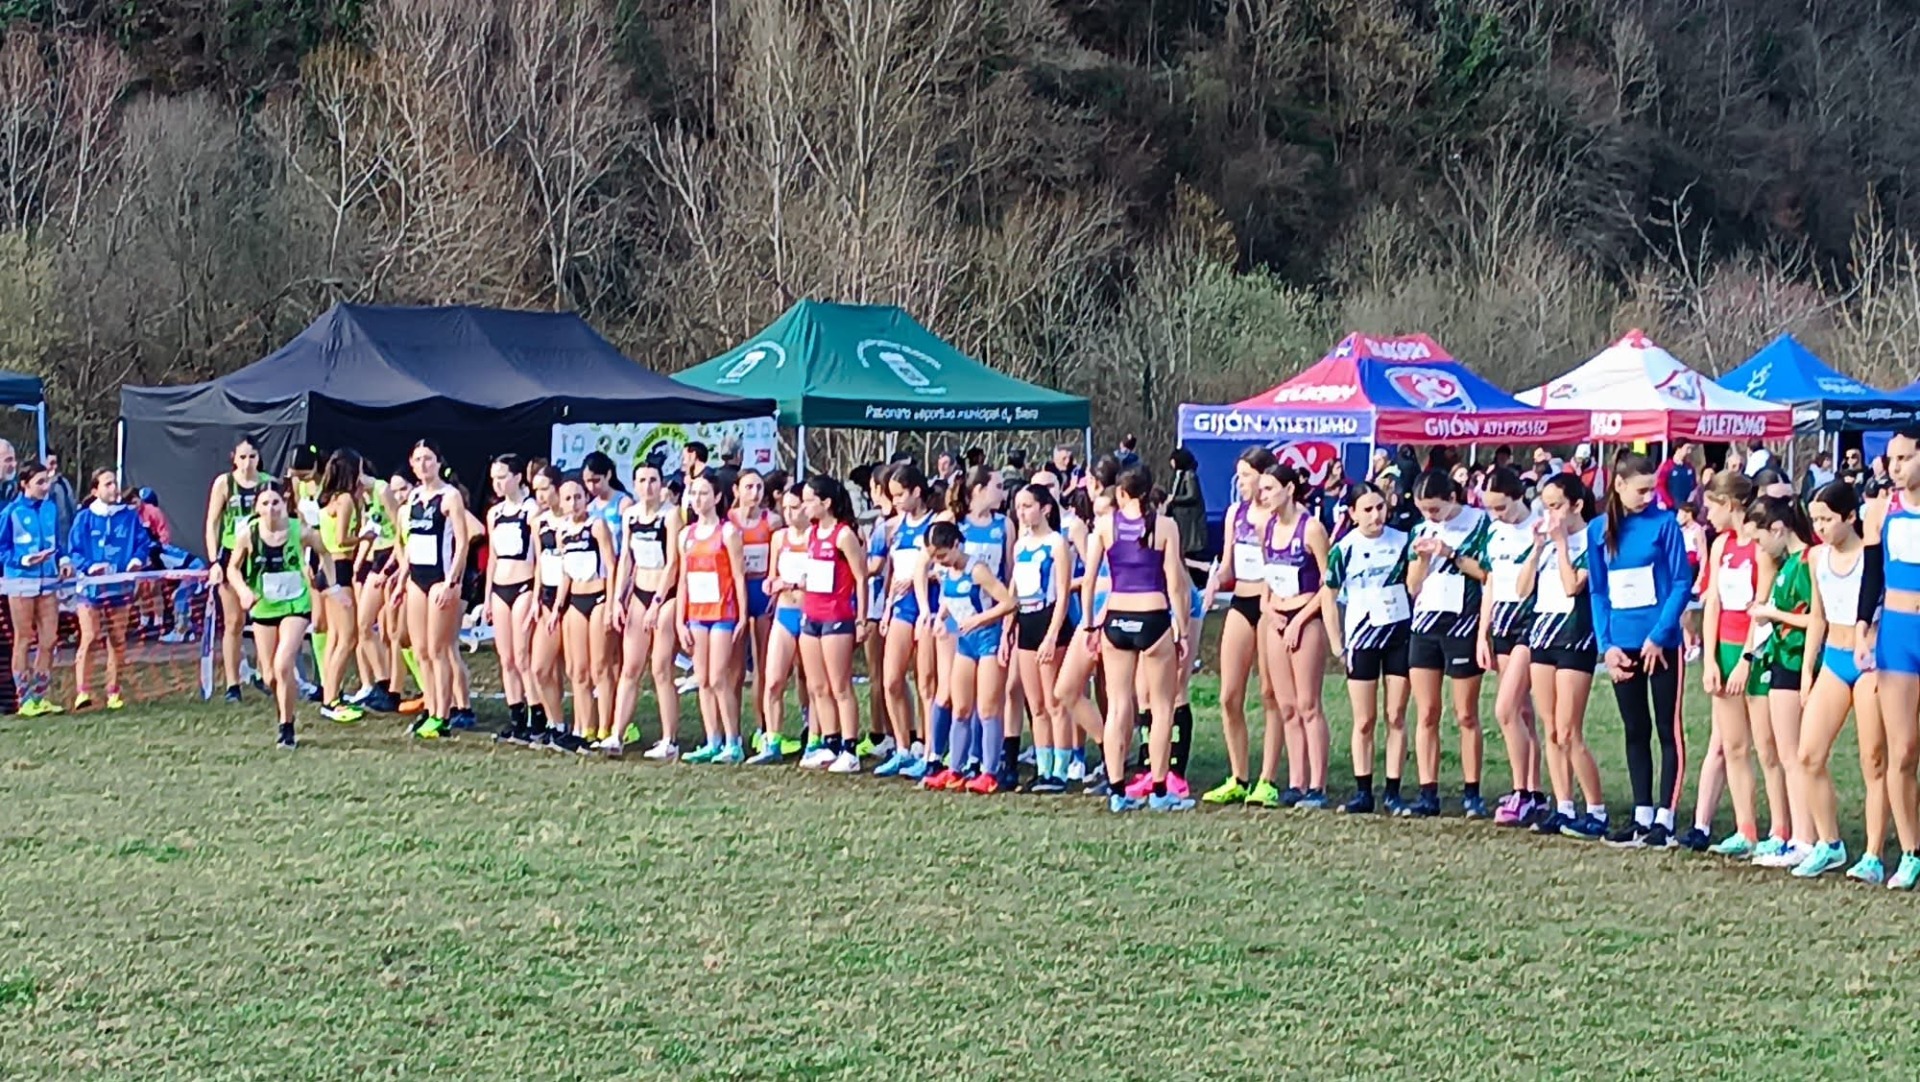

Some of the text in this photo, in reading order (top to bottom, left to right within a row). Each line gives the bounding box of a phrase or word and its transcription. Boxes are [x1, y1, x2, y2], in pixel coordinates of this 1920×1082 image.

[1193, 409, 1358, 436] GIJÓN ATLETISMO
[1424, 414, 1479, 440] GIJÓN
[1694, 413, 1767, 437] ATLETISMO
